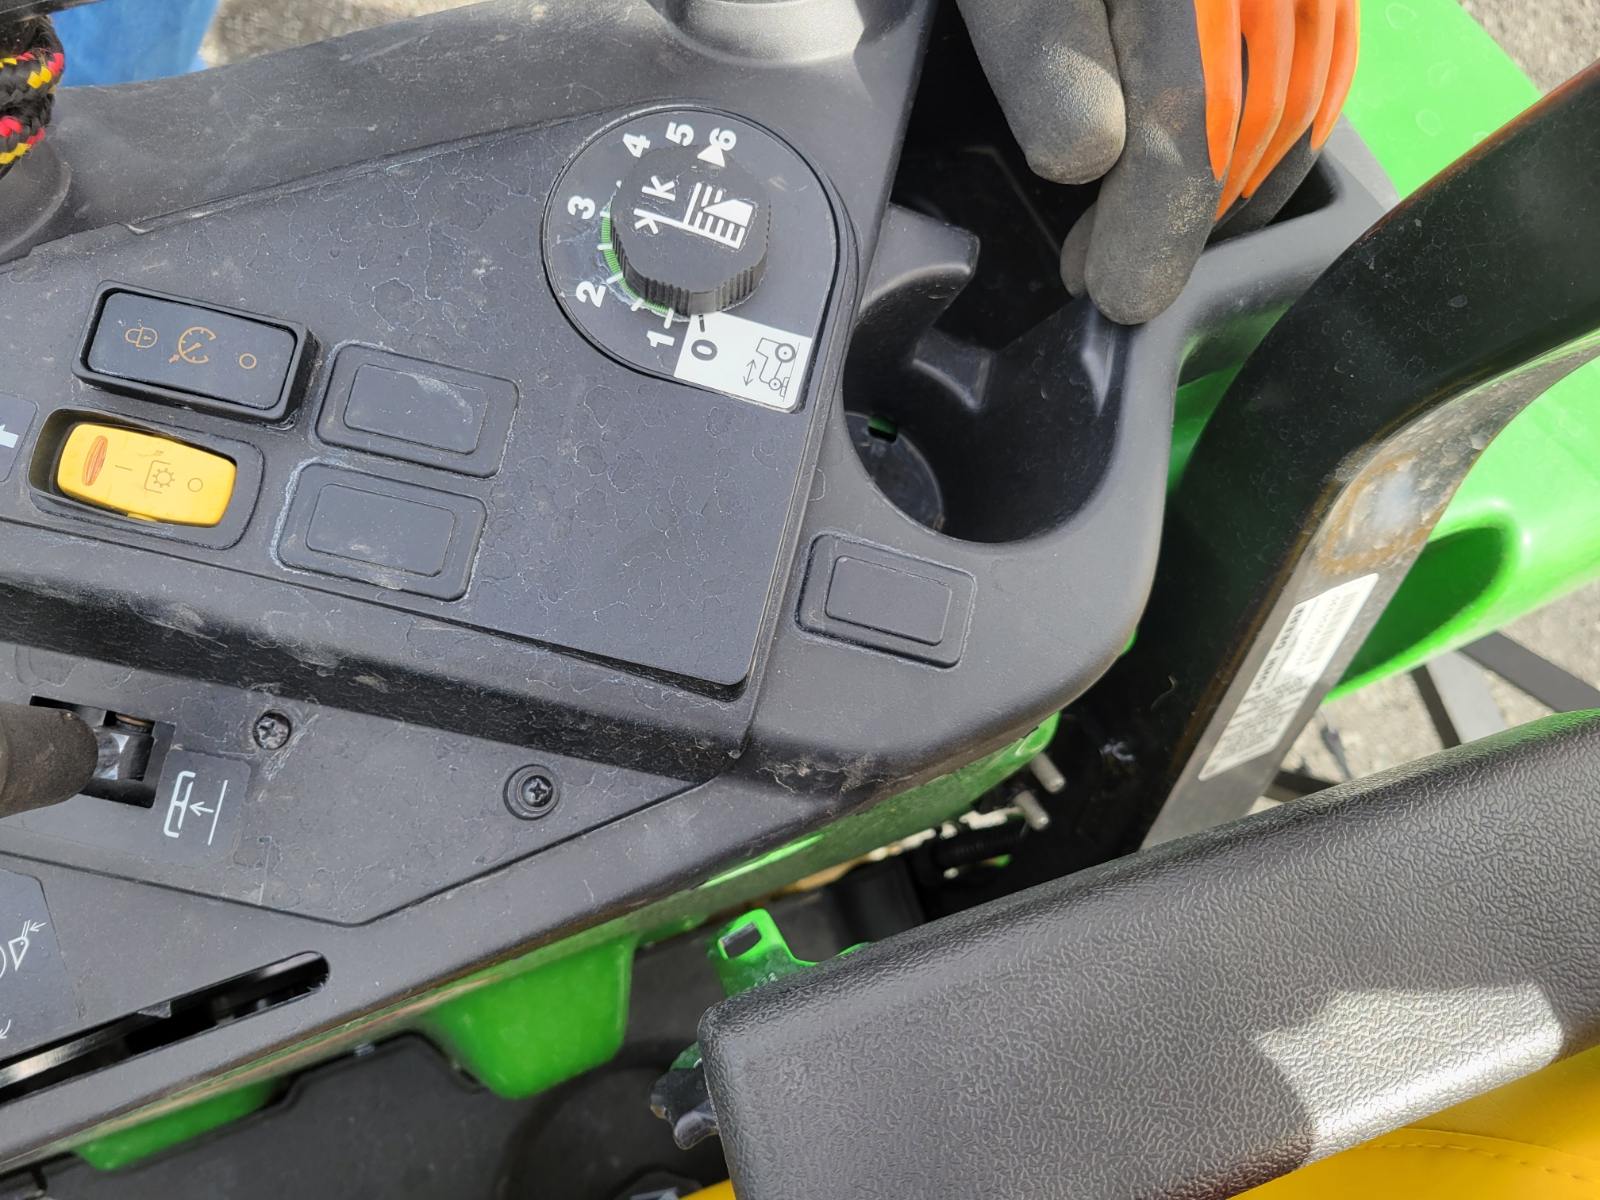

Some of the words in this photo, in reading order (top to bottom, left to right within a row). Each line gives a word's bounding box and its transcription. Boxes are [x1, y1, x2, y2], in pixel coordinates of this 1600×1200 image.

[622, 133, 651, 158] 4
[665, 121, 695, 147] 5
[709, 128, 737, 151] 6
[567, 194, 596, 220] 3
[575, 281, 606, 308] 2
[646, 330, 676, 350] 1
[690, 339, 718, 361] 0
[1253, 656, 1278, 691] JOHN
[1275, 607, 1305, 650] DEERE
